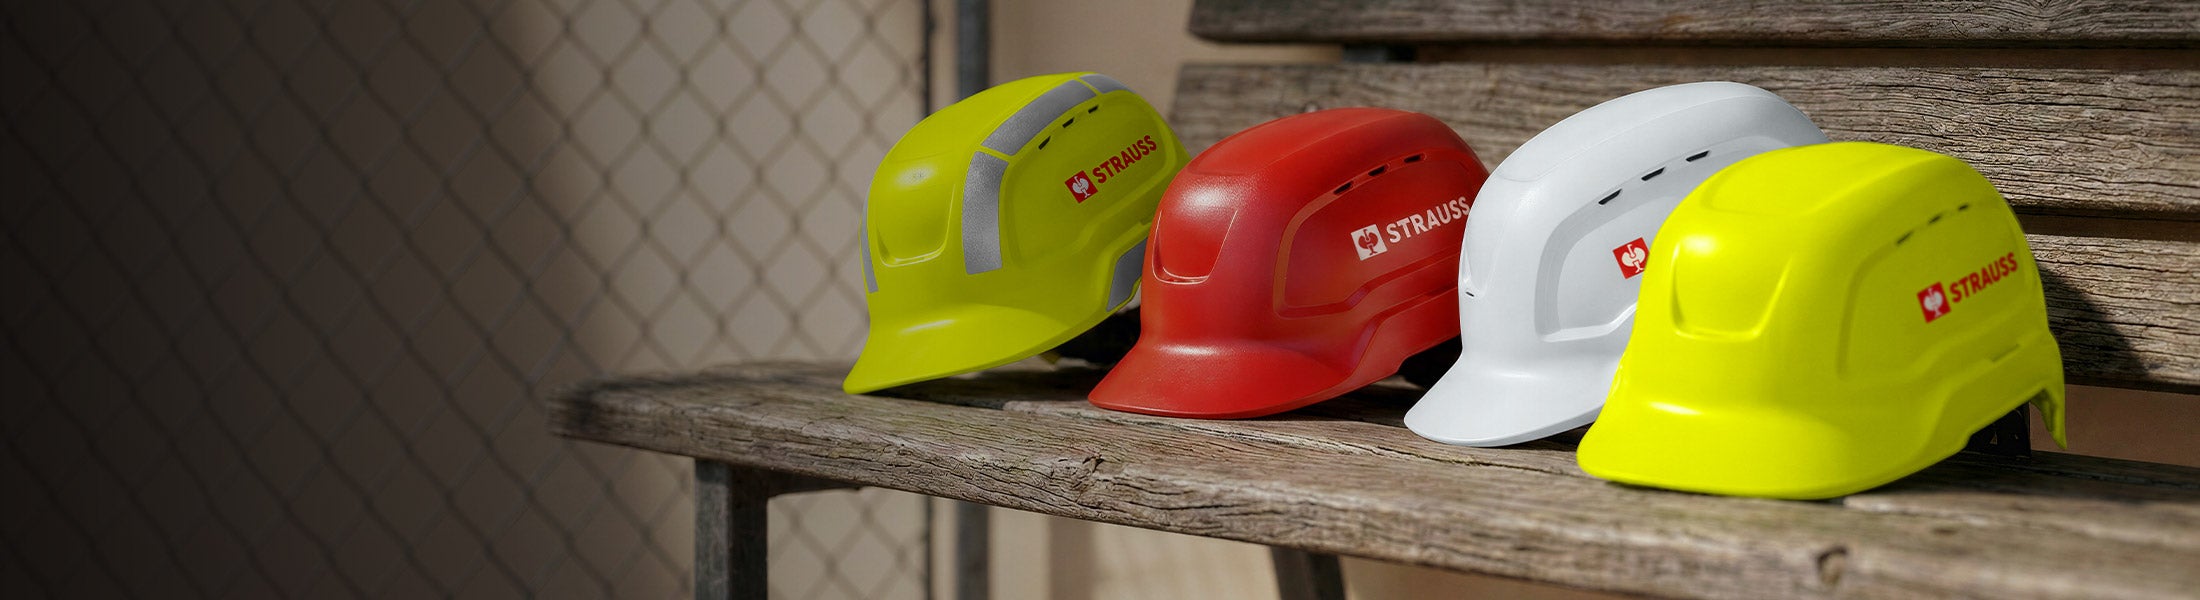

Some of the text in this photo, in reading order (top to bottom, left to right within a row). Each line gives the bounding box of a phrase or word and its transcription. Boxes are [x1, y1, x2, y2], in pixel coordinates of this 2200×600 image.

[1092, 135, 1157, 184] STRAUSS
[1386, 196, 1471, 244] STRAUSS
[1949, 251, 2018, 303] STRAUSS
